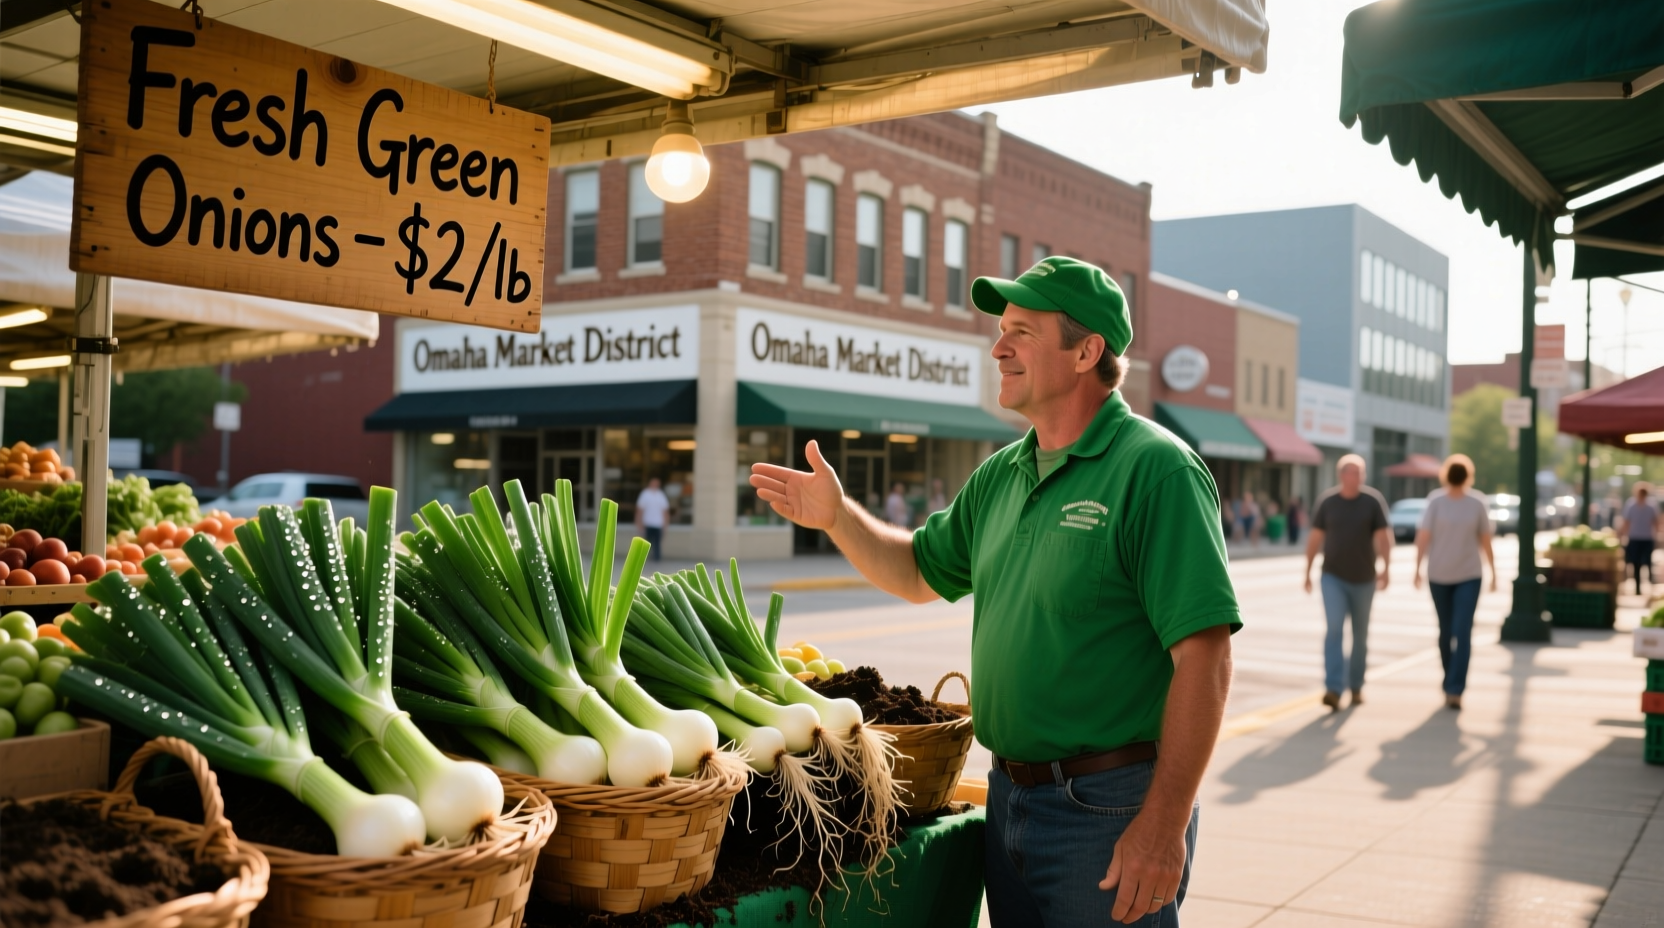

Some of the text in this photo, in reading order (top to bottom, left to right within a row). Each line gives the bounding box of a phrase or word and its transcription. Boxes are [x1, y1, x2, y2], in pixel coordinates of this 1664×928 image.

[127, 25, 519, 205] Fresh Green
[126, 154, 340, 268] Onions
[394, 202, 532, 307] $2/lb
[413, 325, 681, 373] Omaha Market District
[751, 322, 970, 387] Omaha Market District
